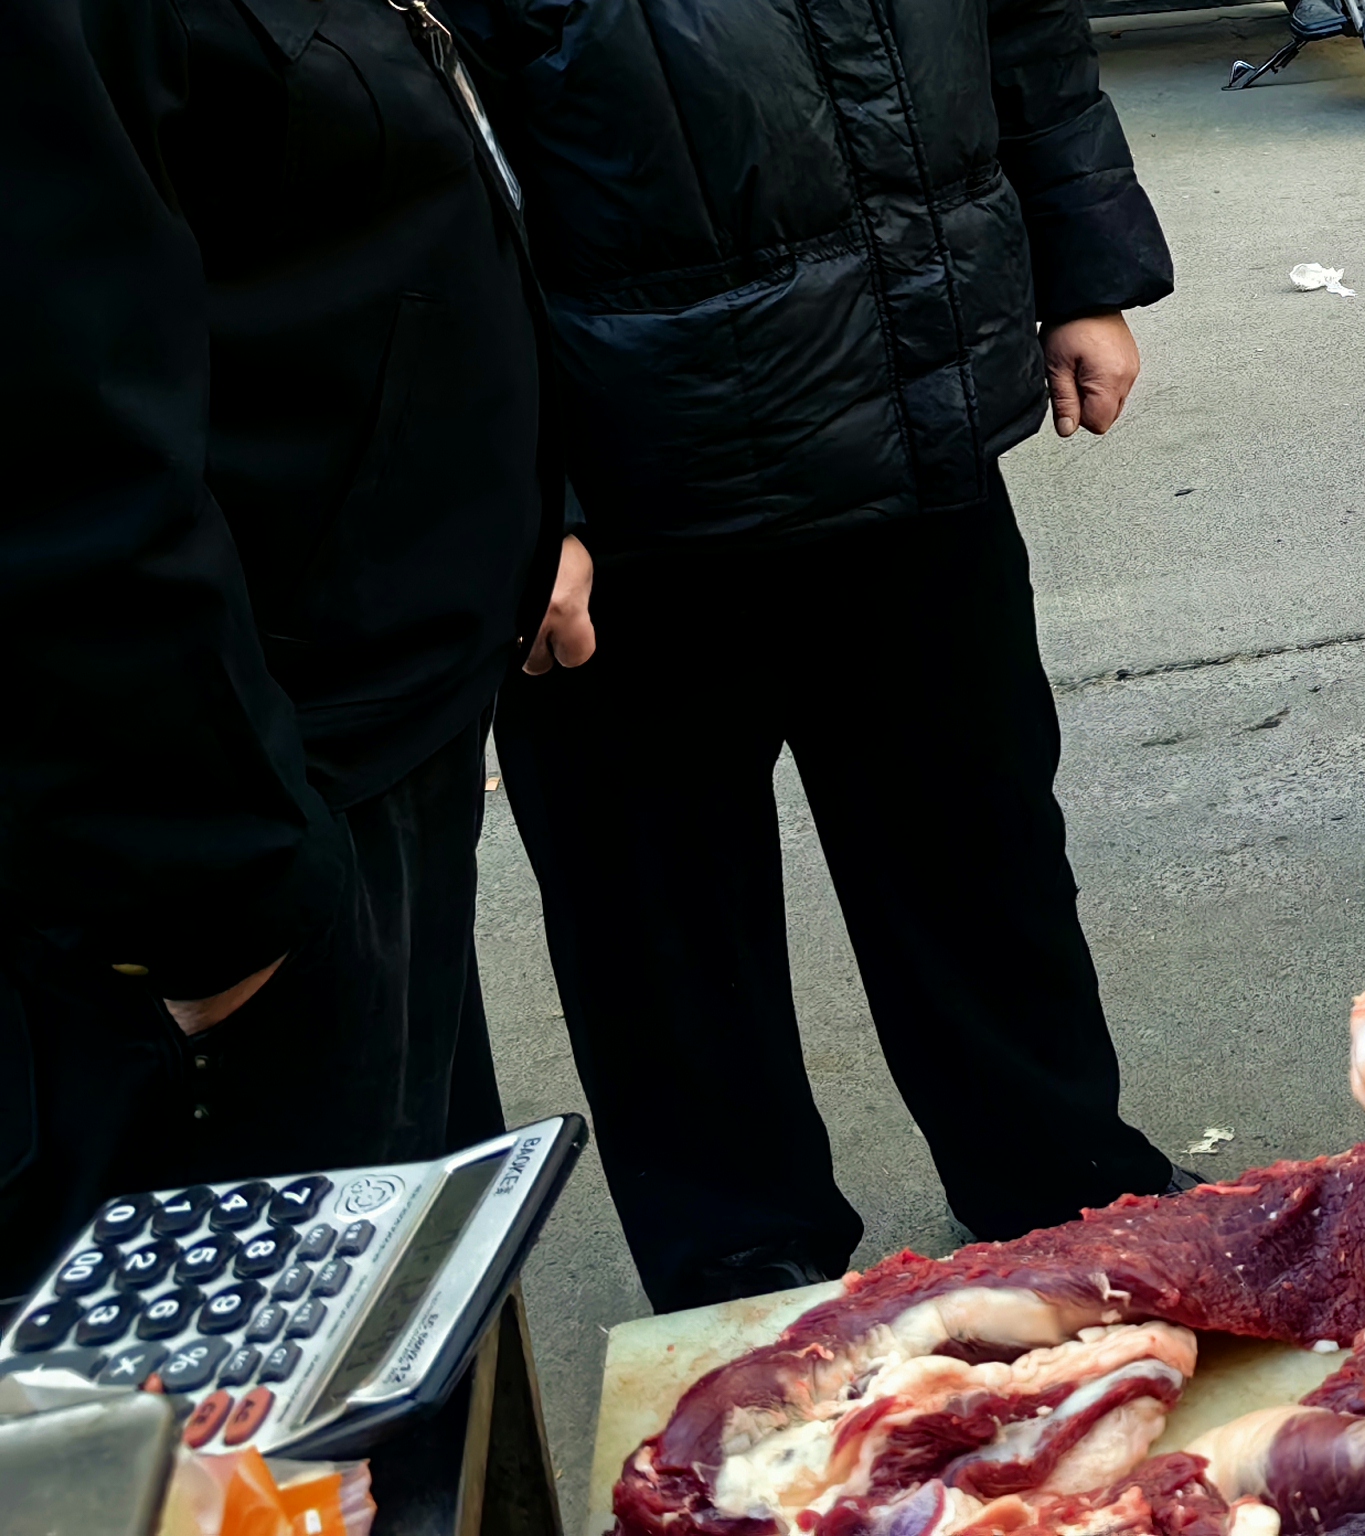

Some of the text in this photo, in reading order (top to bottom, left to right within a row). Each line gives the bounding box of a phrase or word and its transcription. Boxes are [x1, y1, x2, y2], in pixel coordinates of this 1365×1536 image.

[221, 1194, 248, 1211] 4
[283, 1187, 310, 1205] 7
[106, 1205, 135, 1222] 0
[165, 1201, 191, 1213] 1
[186, 1247, 217, 1264] 5
[246, 1240, 276, 1258] 8
[63, 1251, 104, 1281] 00
[125, 1252, 156, 1270] 2
[150, 1300, 178, 1318] 6
[211, 1294, 241, 1313] 9
[88, 1305, 119, 1325] 3
